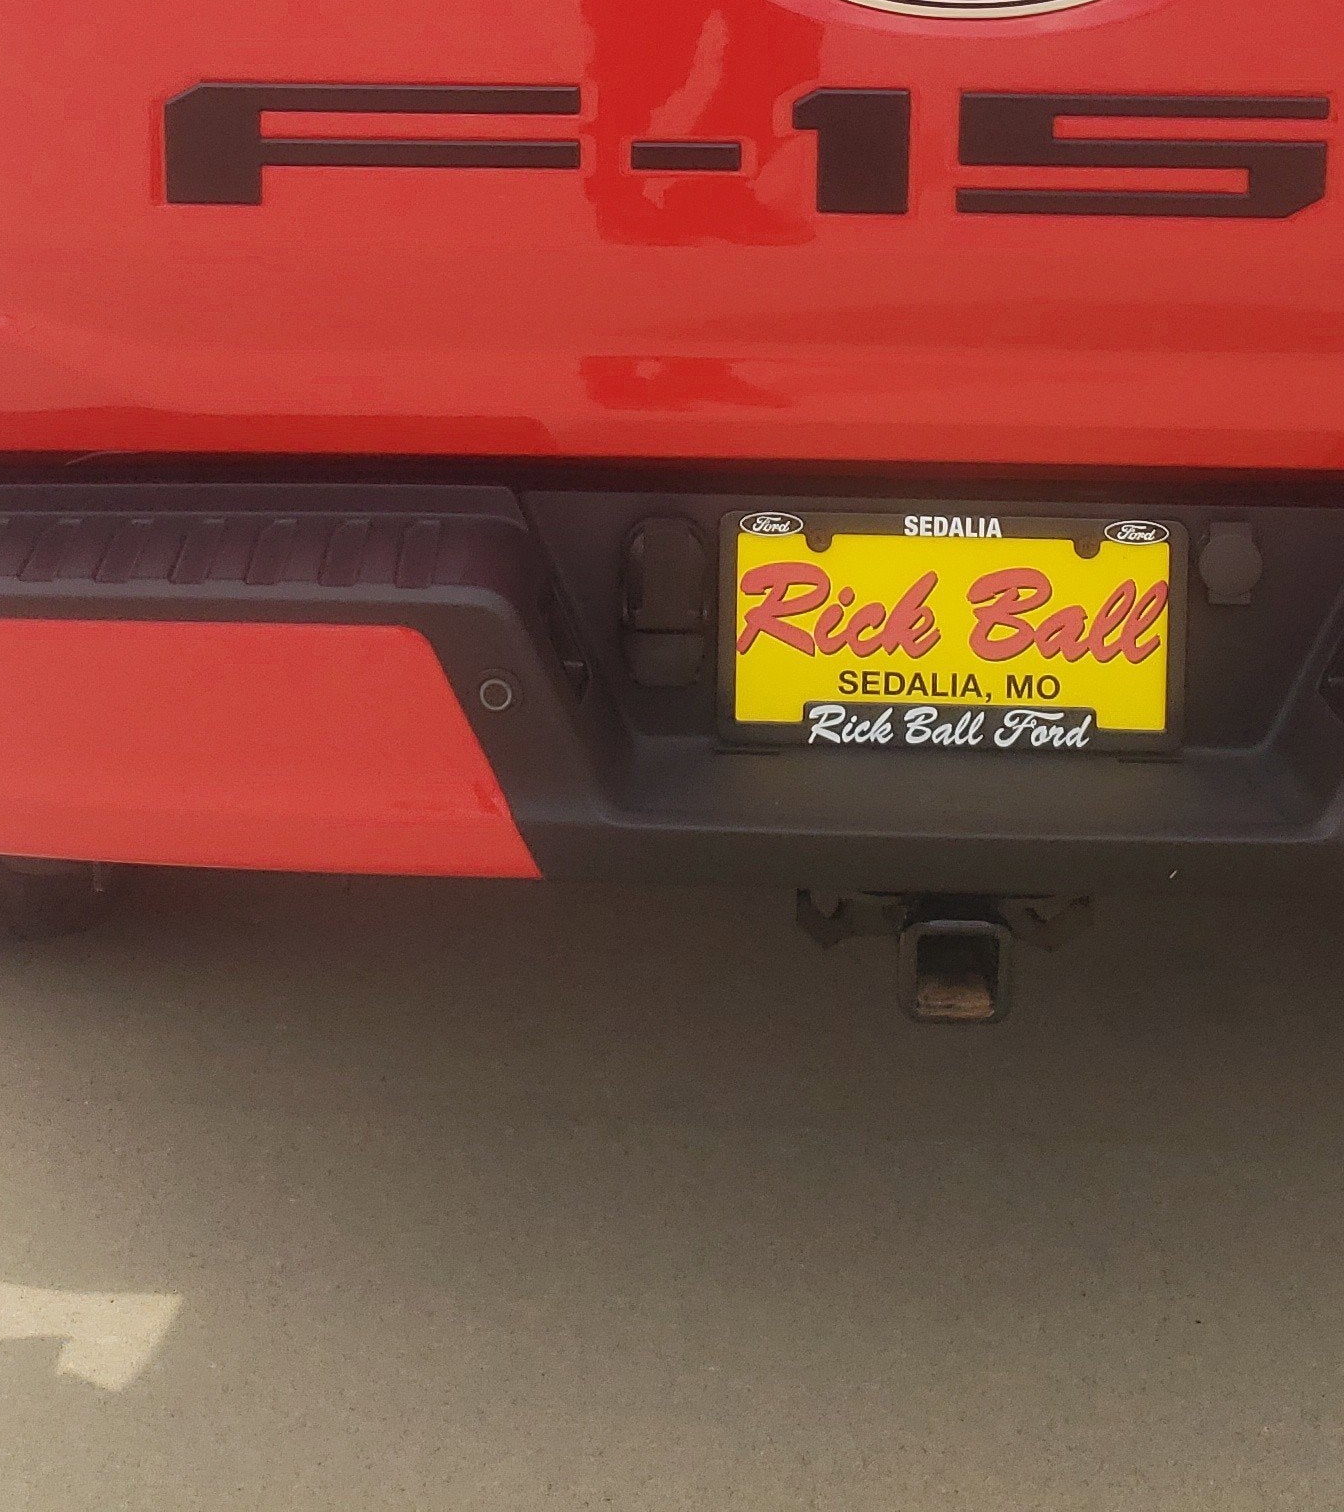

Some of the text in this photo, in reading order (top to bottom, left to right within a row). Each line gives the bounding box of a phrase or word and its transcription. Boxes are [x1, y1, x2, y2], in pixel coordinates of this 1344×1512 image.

[752, 516, 791, 532] Ford
[903, 515, 1003, 539] SEDALIA
[1117, 524, 1156, 541] Ford
[736, 561, 1170, 664] Rick Ball
[838, 670, 1061, 703] SEDALIA, MO
[807, 705, 1090, 749] Rick Ball Ford
